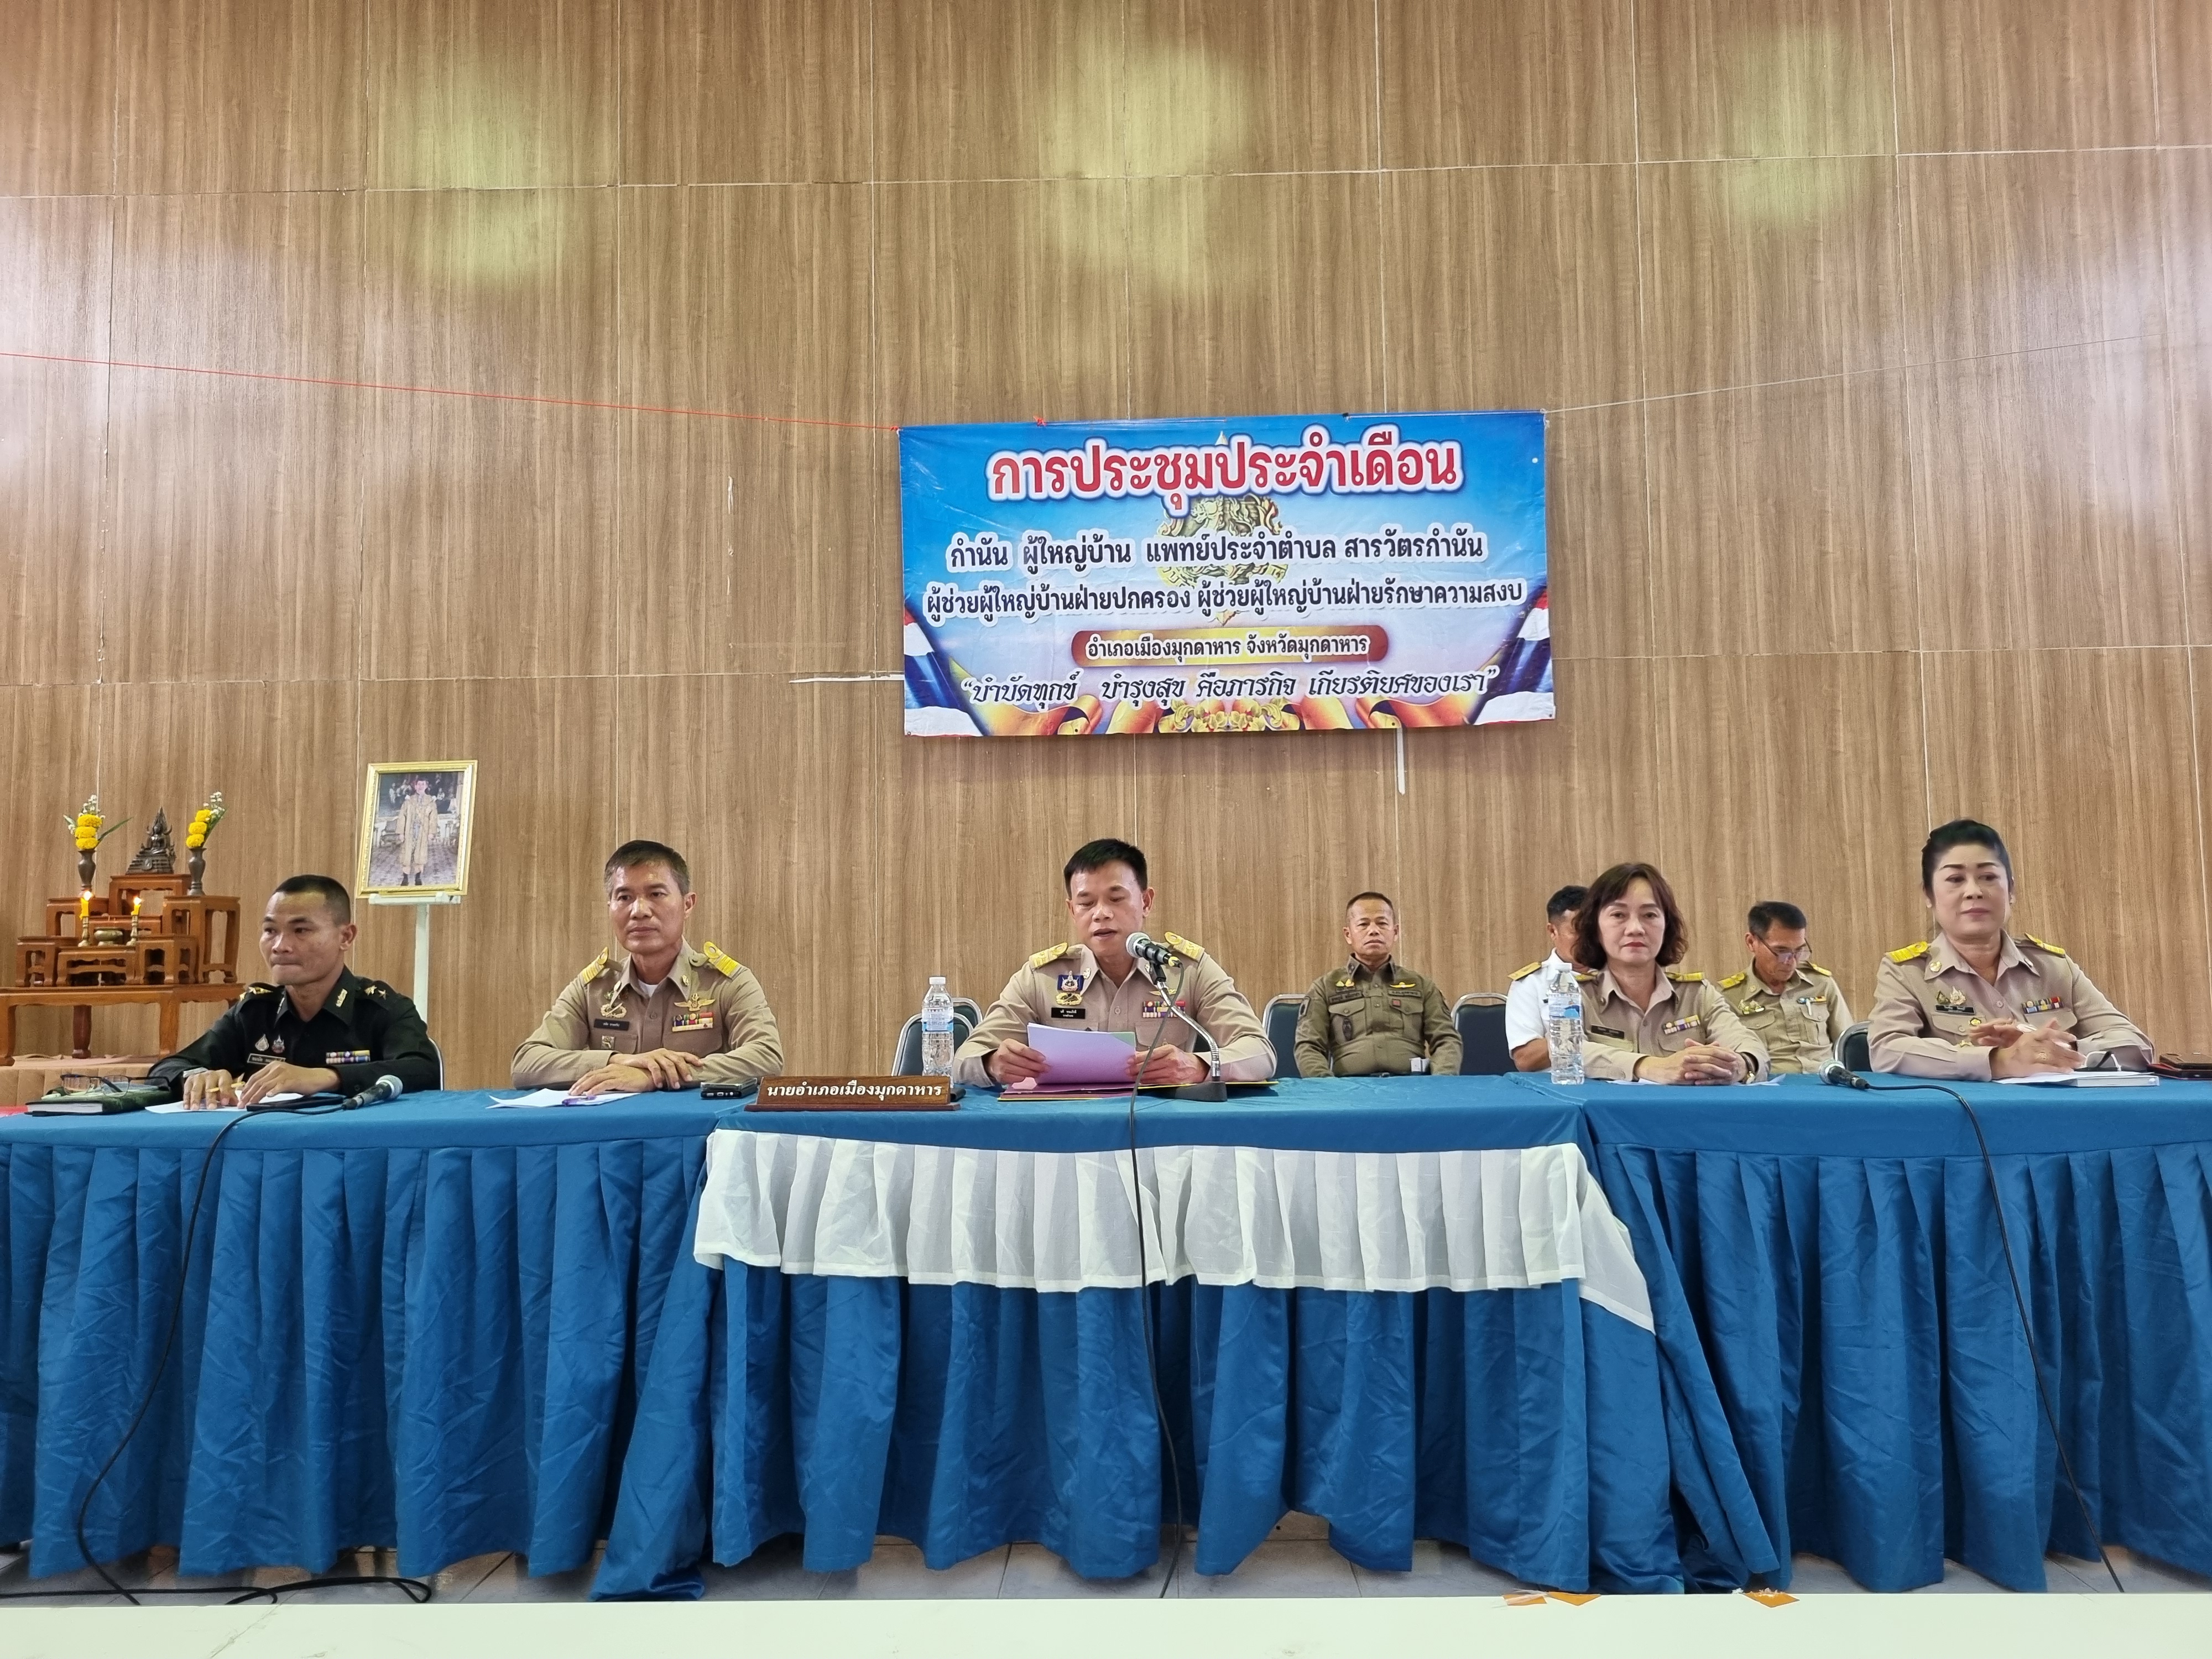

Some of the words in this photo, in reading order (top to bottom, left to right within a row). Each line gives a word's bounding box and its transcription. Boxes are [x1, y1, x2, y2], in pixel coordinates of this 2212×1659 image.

[993, 430, 1457, 510] การประชุมประจำเดือน
[951, 538, 1008, 567] กำนัน
[1023, 534, 1131, 575] ผู้ใหญ่บ้าน
[1146, 531, 1337, 562] แพทย์ประจำตำบล
[1344, 528, 1483, 558] สารวัตรกำนัน
[927, 583, 1190, 623] ผู้ช่วยผู้ใหญ่บ้านฝ่ายปกครอง
[1198, 577, 1522, 617] ผู้ช่วยผู้ใหญ่บ้านฝ่ายรักษาความสงบ
[1088, 636, 1241, 663] อำเภอเมืองมุกดาหาร
[1246, 633, 1368, 660] จังหวัดมุกดาหาร
[1101, 673, 1186, 707] บำรุงสุข
[1196, 671, 1296, 697] คือภารกิจ
[767, 1079, 942, 1101] นายอำเภอเมืองมุกดาหาร
